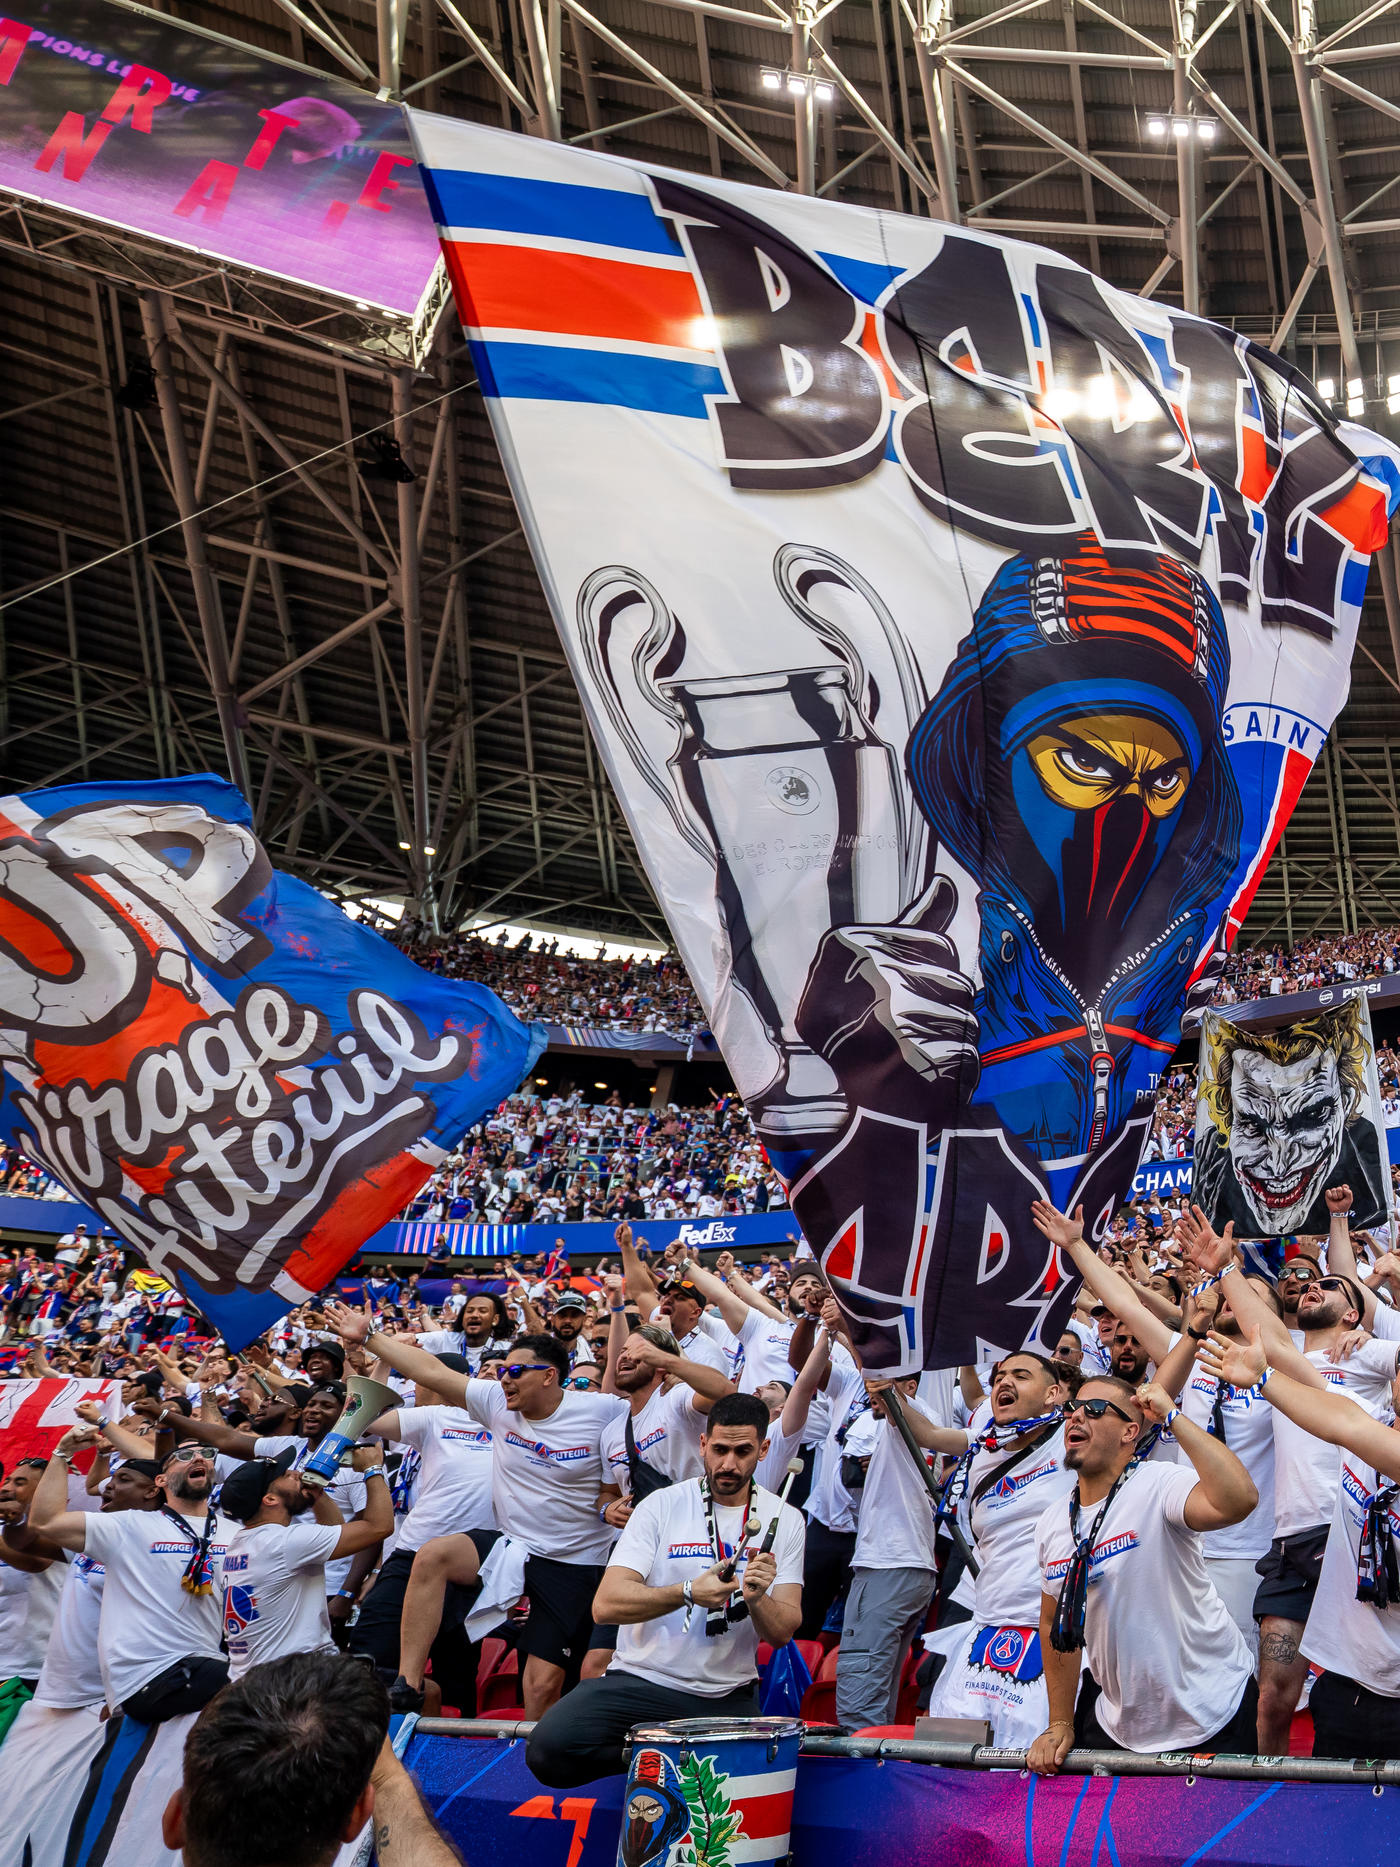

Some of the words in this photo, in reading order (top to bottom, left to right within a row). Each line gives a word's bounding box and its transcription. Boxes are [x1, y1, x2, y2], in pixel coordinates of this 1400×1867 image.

[1131, 1167, 1193, 1193] CHAM
[678, 1221, 737, 1246] FedEx
[444, 1430, 476, 1441] VIRAGE
[1017, 1461, 1055, 1488] AUTEUIL
[1341, 1468, 1367, 1501] VIRAGE
[154, 1543, 191, 1553] VIRAGE
[671, 1544, 713, 1558] VIRAGE
[1094, 1532, 1135, 1563] AUTEUIL
